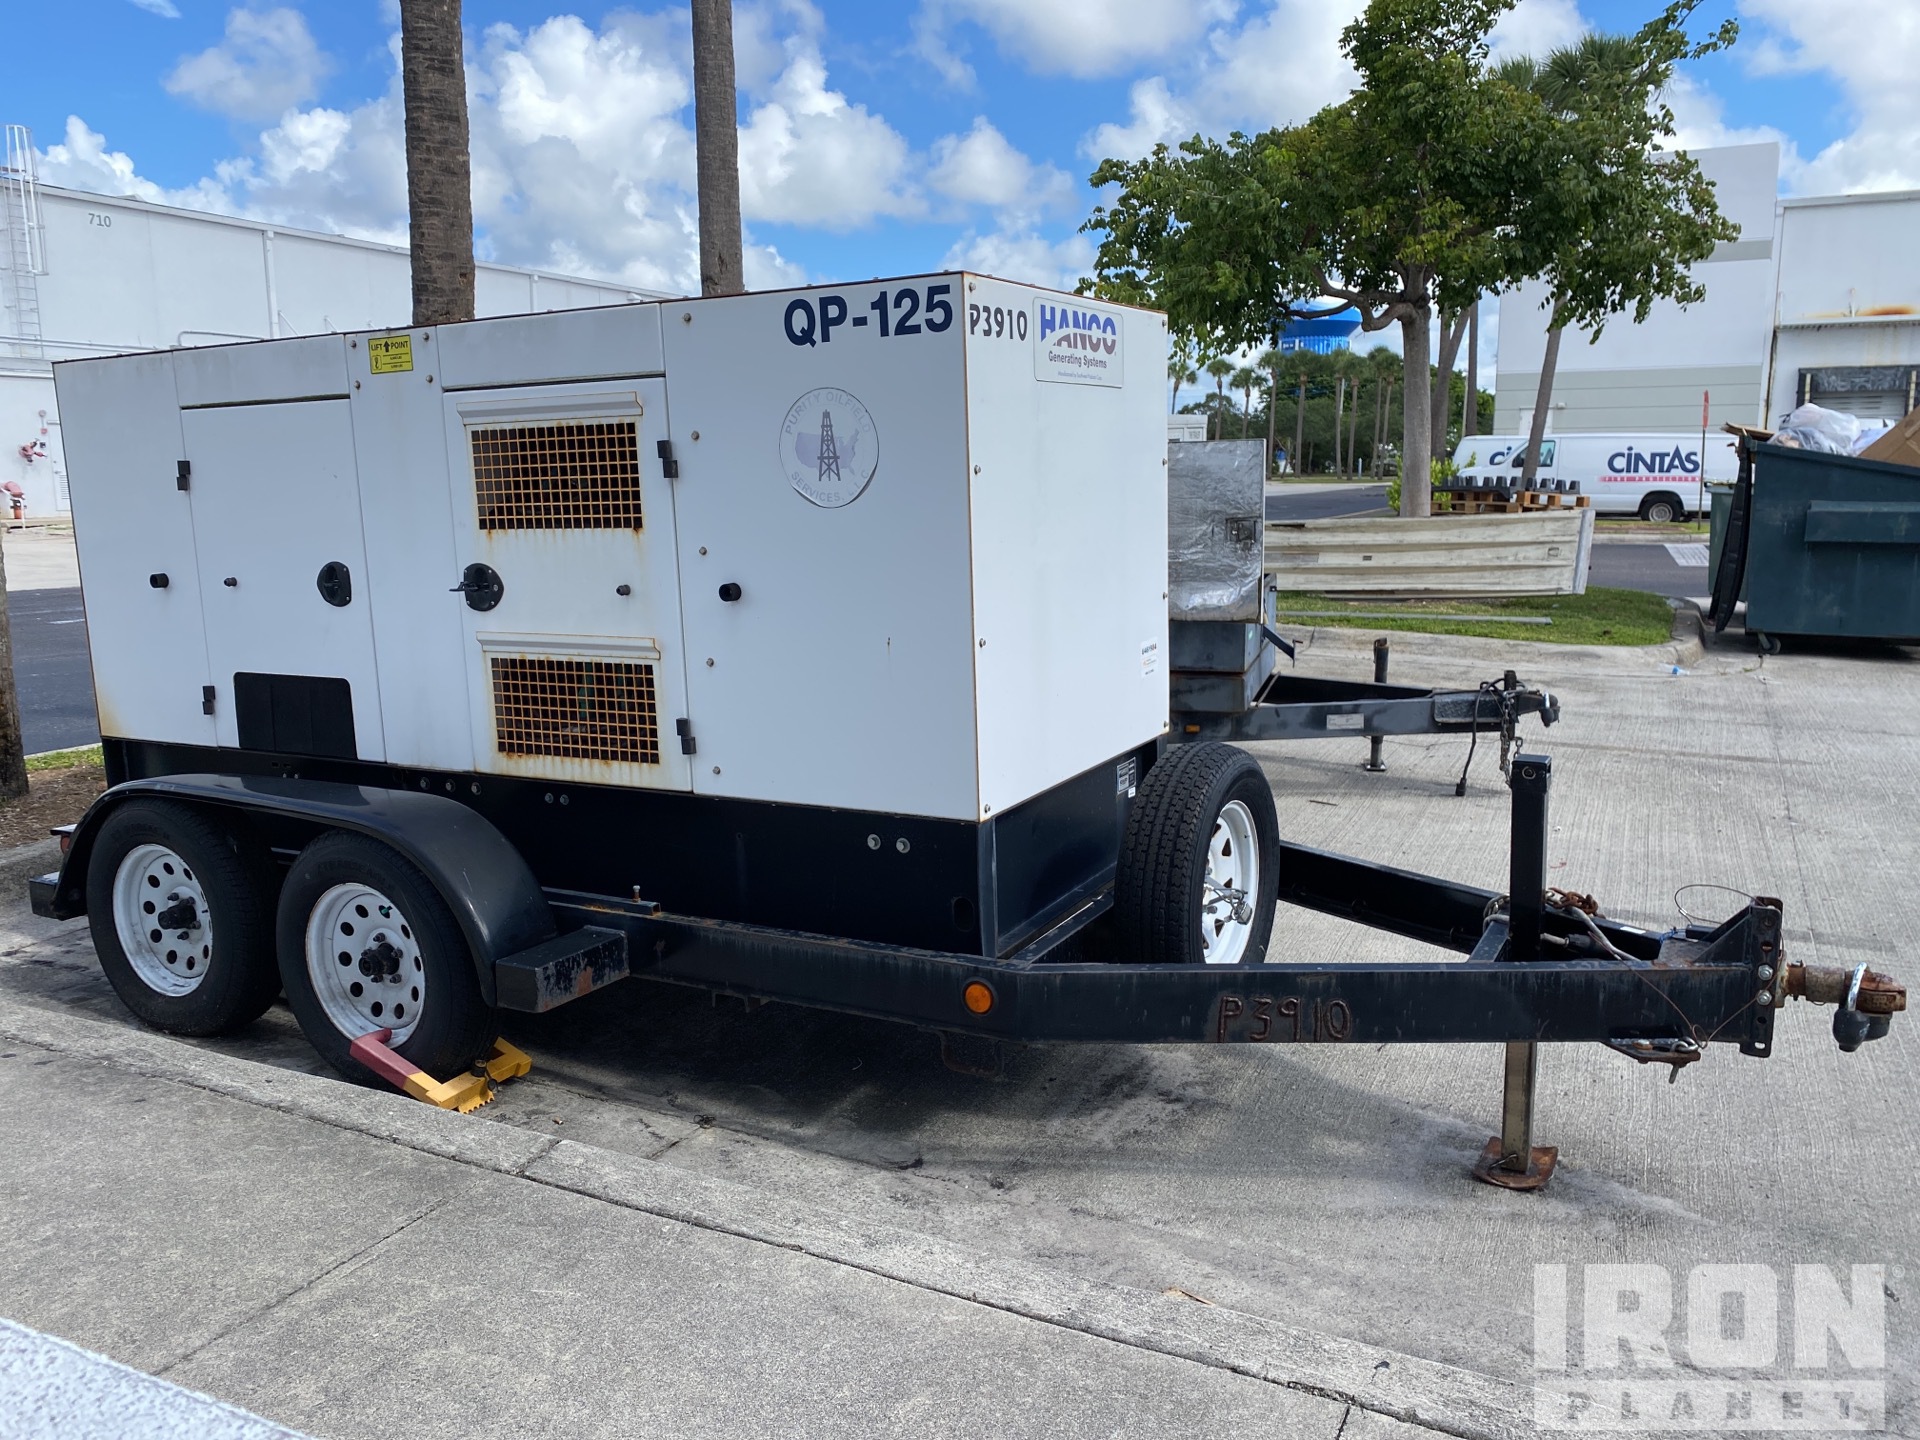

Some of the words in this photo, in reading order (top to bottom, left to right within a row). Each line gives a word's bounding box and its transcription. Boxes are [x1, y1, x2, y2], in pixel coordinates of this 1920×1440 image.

[88, 212, 112, 228] 710
[784, 284, 953, 348] QP-125
[969, 303, 1028, 341] P3910
[1040, 304, 1117, 355] HANCO
[370, 343, 383, 351] LIFT
[390, 340, 409, 350] POINT
[1048, 350, 1082, 368] Generating
[1083, 354, 1107, 369] Systems
[785, 391, 821, 435] PURITY
[825, 391, 871, 433] OILFIELD
